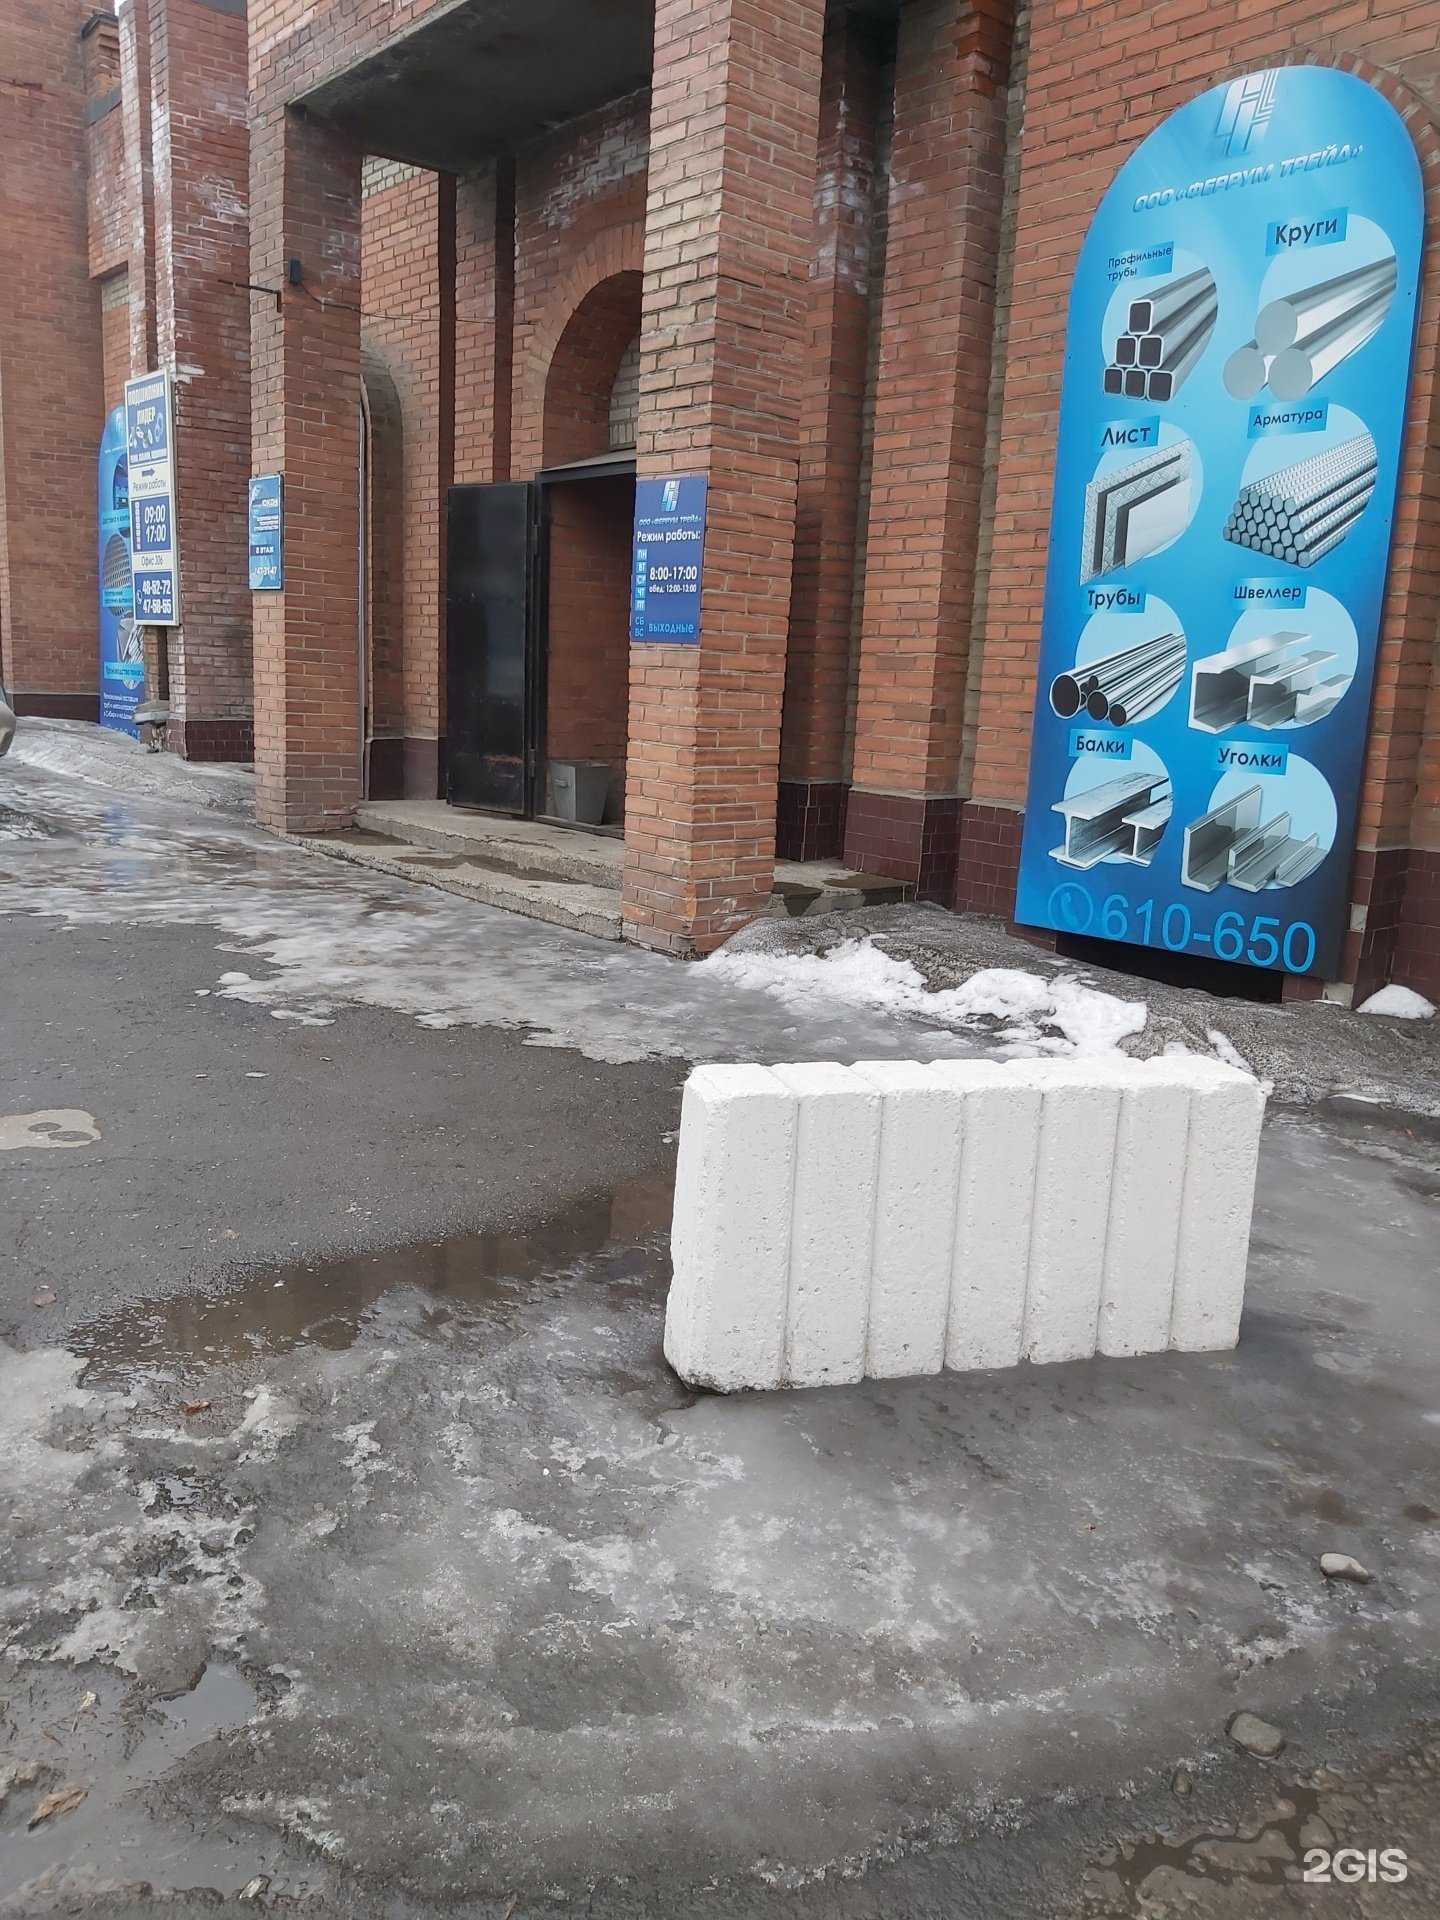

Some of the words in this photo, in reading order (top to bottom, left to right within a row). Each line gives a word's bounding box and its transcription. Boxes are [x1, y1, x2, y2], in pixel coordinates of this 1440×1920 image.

[1132, 188, 1175, 213] ООО
[1275, 216, 1339, 248] Круги
[1108, 246, 1172, 269] Профильные
[1107, 266, 1138, 282] трубы
[1253, 409, 1324, 428] Арматура
[1101, 426, 1152, 447] Лист
[144, 504, 166, 524] 09:00
[146, 524, 167, 543] 17:00
[637, 530, 664, 543] Режим
[649, 566, 698, 580] 8:00-17:00
[1087, 588, 1141, 610] Трубы
[1233, 585, 1302, 602] Швеллер
[635, 616, 645, 625] СБ
[635, 628, 644, 637] ВС
[1076, 735, 1126, 754] Балки
[1217, 747, 1283, 769] Уголки
[1102, 893, 1316, 974] 610-650
